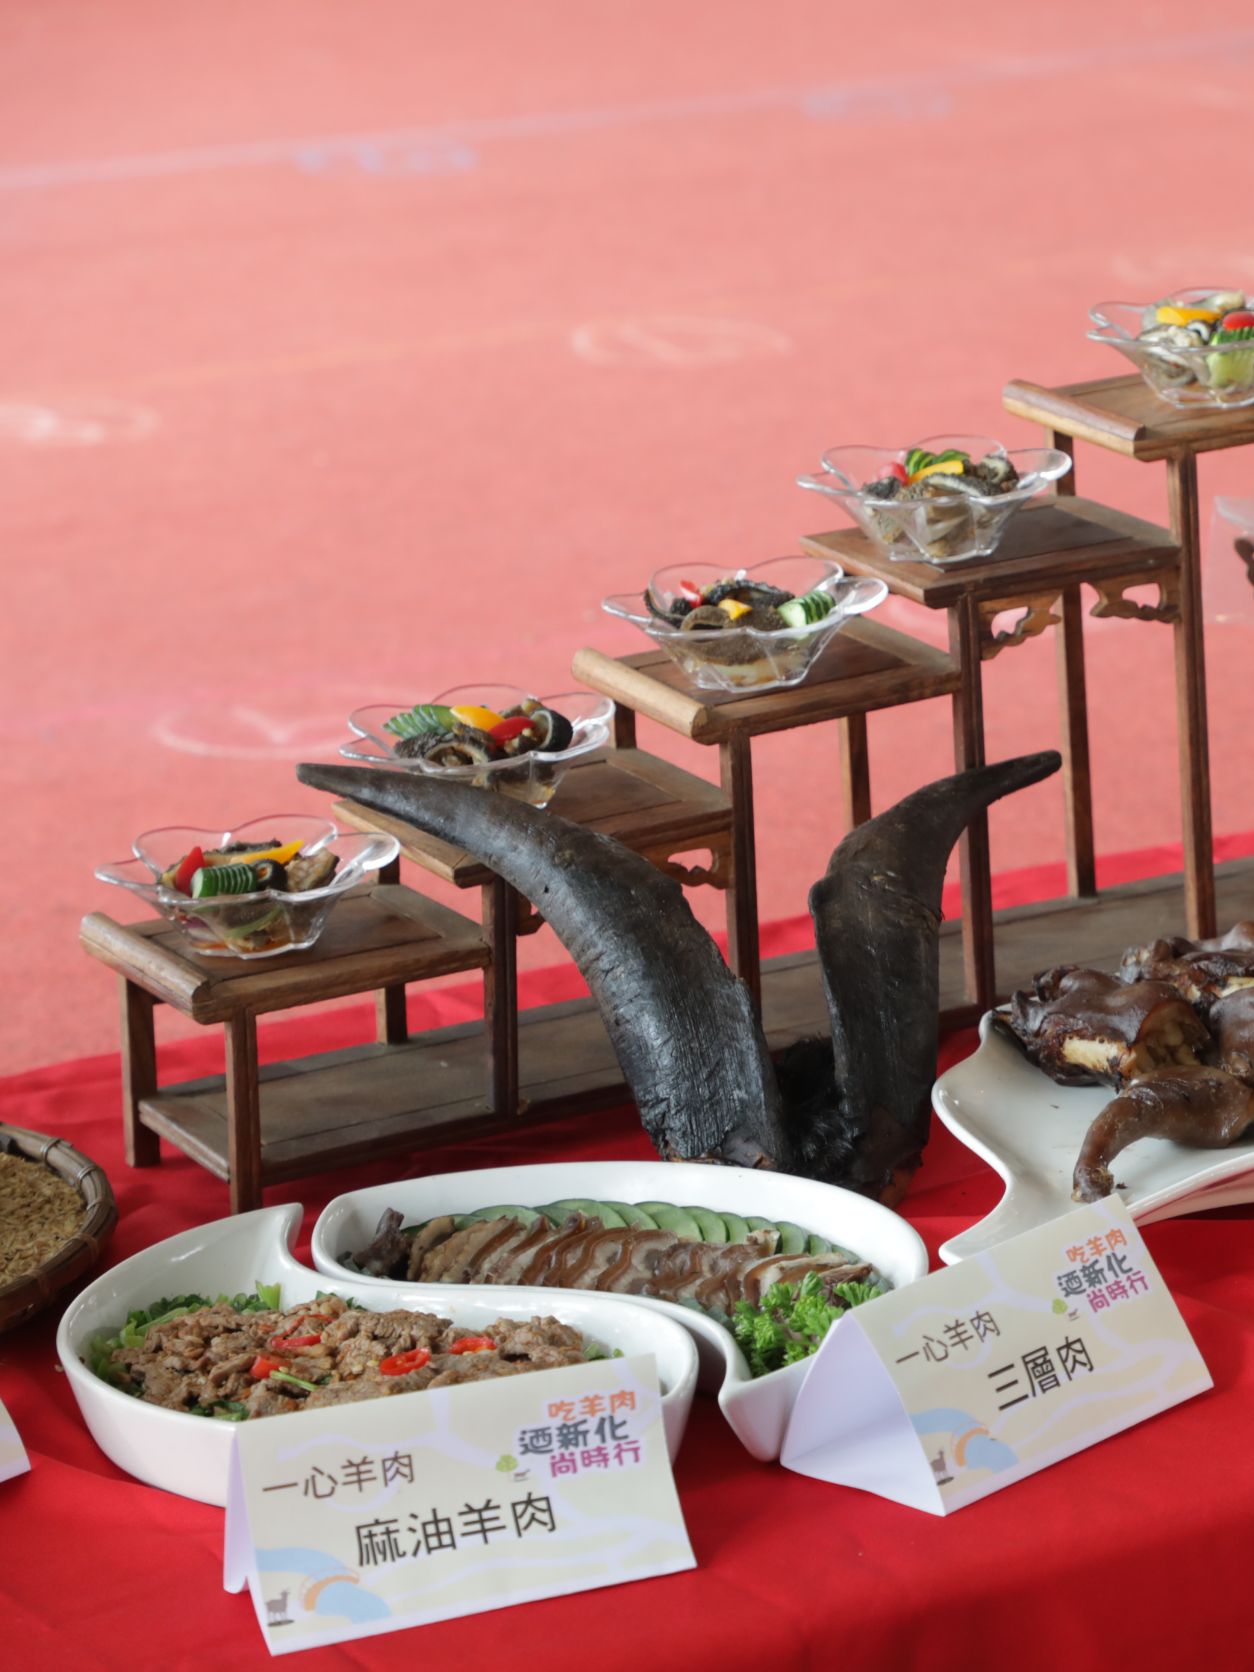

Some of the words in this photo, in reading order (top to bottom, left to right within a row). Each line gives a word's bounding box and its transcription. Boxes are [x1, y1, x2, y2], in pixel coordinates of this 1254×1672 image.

[1066, 1229, 1127, 1264] 吃羊肉
[1086, 1270, 1148, 1313] 尚時行
[895, 1310, 1001, 1364] 一心羊肉
[987, 1336, 1094, 1411] 三層肉
[547, 1390, 636, 1422] 吃羊肉
[262, 1451, 415, 1500] 一心羊肉
[550, 1440, 641, 1478] 尚時行
[355, 1492, 557, 1567] 麻油羊肉
